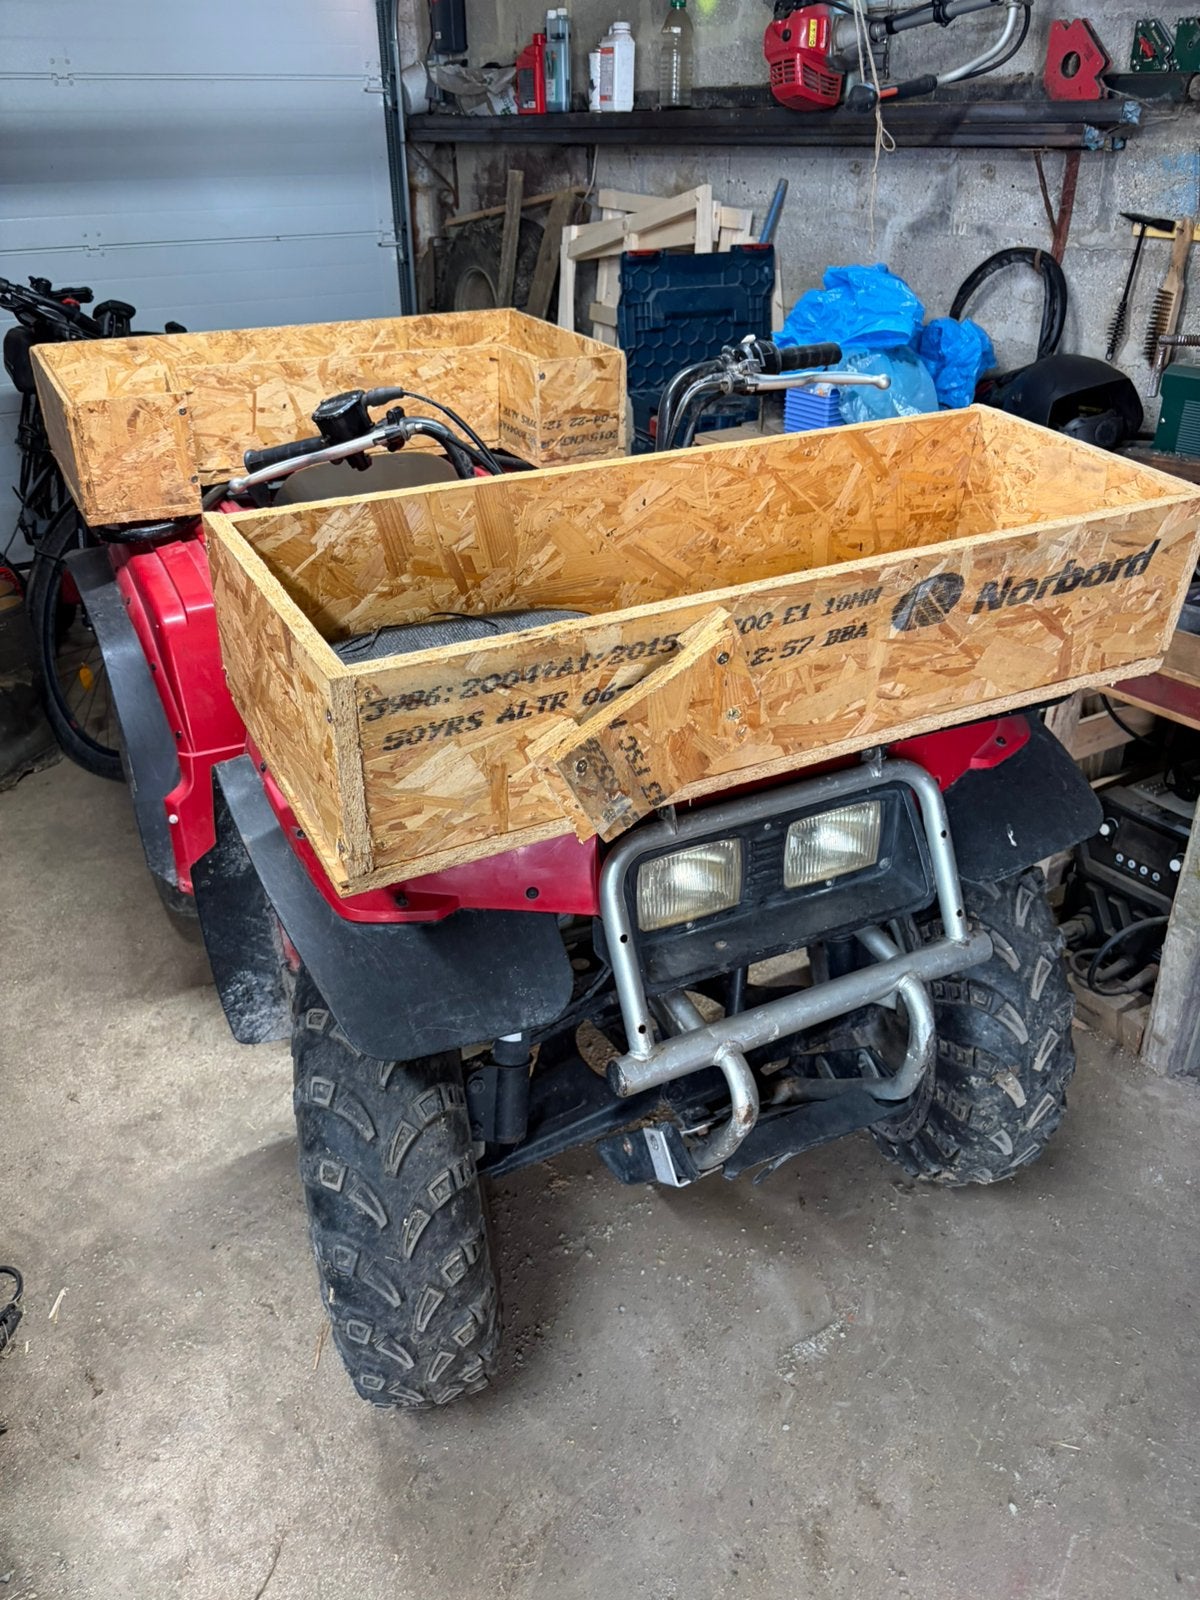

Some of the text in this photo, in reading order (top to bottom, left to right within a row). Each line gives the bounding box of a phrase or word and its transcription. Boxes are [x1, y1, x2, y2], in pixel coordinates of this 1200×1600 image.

[782, 603, 812, 626] E1
[972, 538, 1161, 614] Norbord
[382, 710, 485, 751] 50YRS
[496, 690, 569, 725] ALTR
[745, 634, 816, 667] 2:57
[821, 622, 869, 648] BBA
